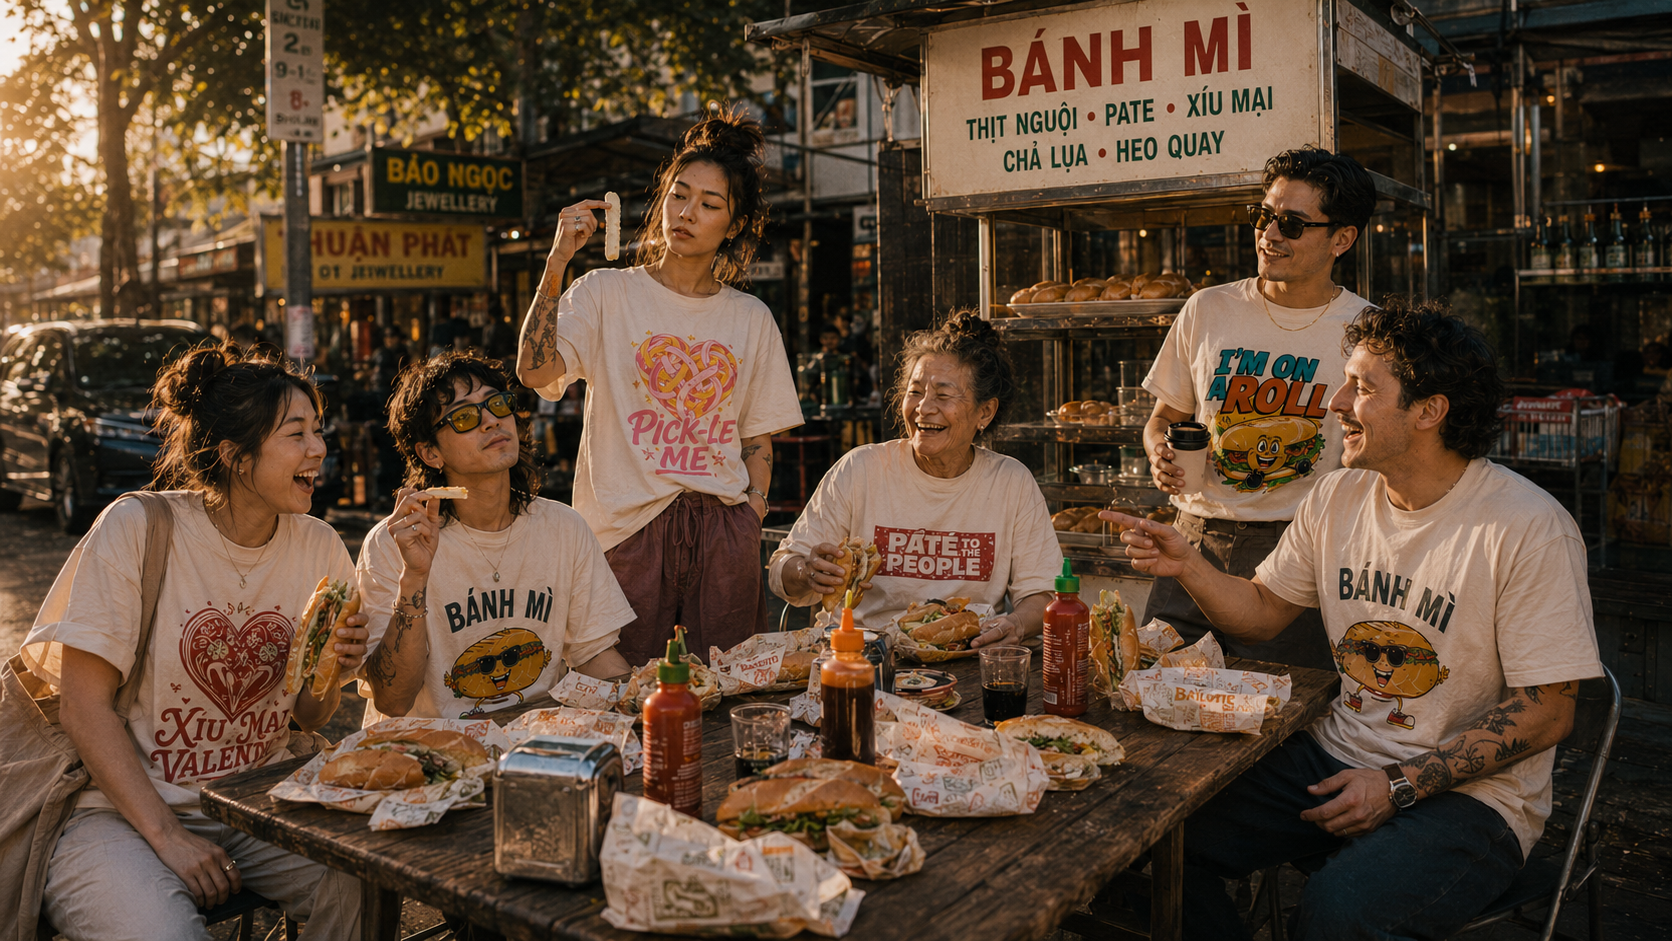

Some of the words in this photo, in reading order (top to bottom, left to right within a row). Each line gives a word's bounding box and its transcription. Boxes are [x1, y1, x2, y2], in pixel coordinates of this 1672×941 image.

[981, 25, 1153, 101] BÁNH
[1183, 2, 1252, 77] MÌ
[966, 115, 1007, 143] THỊT
[1016, 101, 1077, 136] NGUỘI
[1105, 99, 1155, 126] PATE
[1186, 85, 1223, 118] XÍU
[1231, 86, 1273, 117] MẠI
[1003, 141, 1042, 173] CHẢ
[1051, 143, 1088, 173] LỤA
[1116, 137, 1158, 163] HEO
[1168, 130, 1225, 160] QUAY
[447, 162, 514, 195] NGỌC
[278, 226, 391, 262] HUẬN
[402, 228, 472, 258] PHÁT
[1214, 347, 1270, 376] I'M
[1272, 354, 1320, 383] ON
[1205, 376, 1227, 401] A
[1220, 375, 1328, 419] ROLL
[659, 445, 710, 471] ME
[961, 538, 980, 549] TO
[961, 549, 981, 557] THE
[886, 553, 981, 576] PEOPLE
[444, 587, 515, 634] BÁNH
[524, 586, 553, 624] MÌ
[1339, 561, 1412, 611] BÁNH
[1415, 586, 1456, 634] MÌ
[154, 707, 227, 748] XÍU
